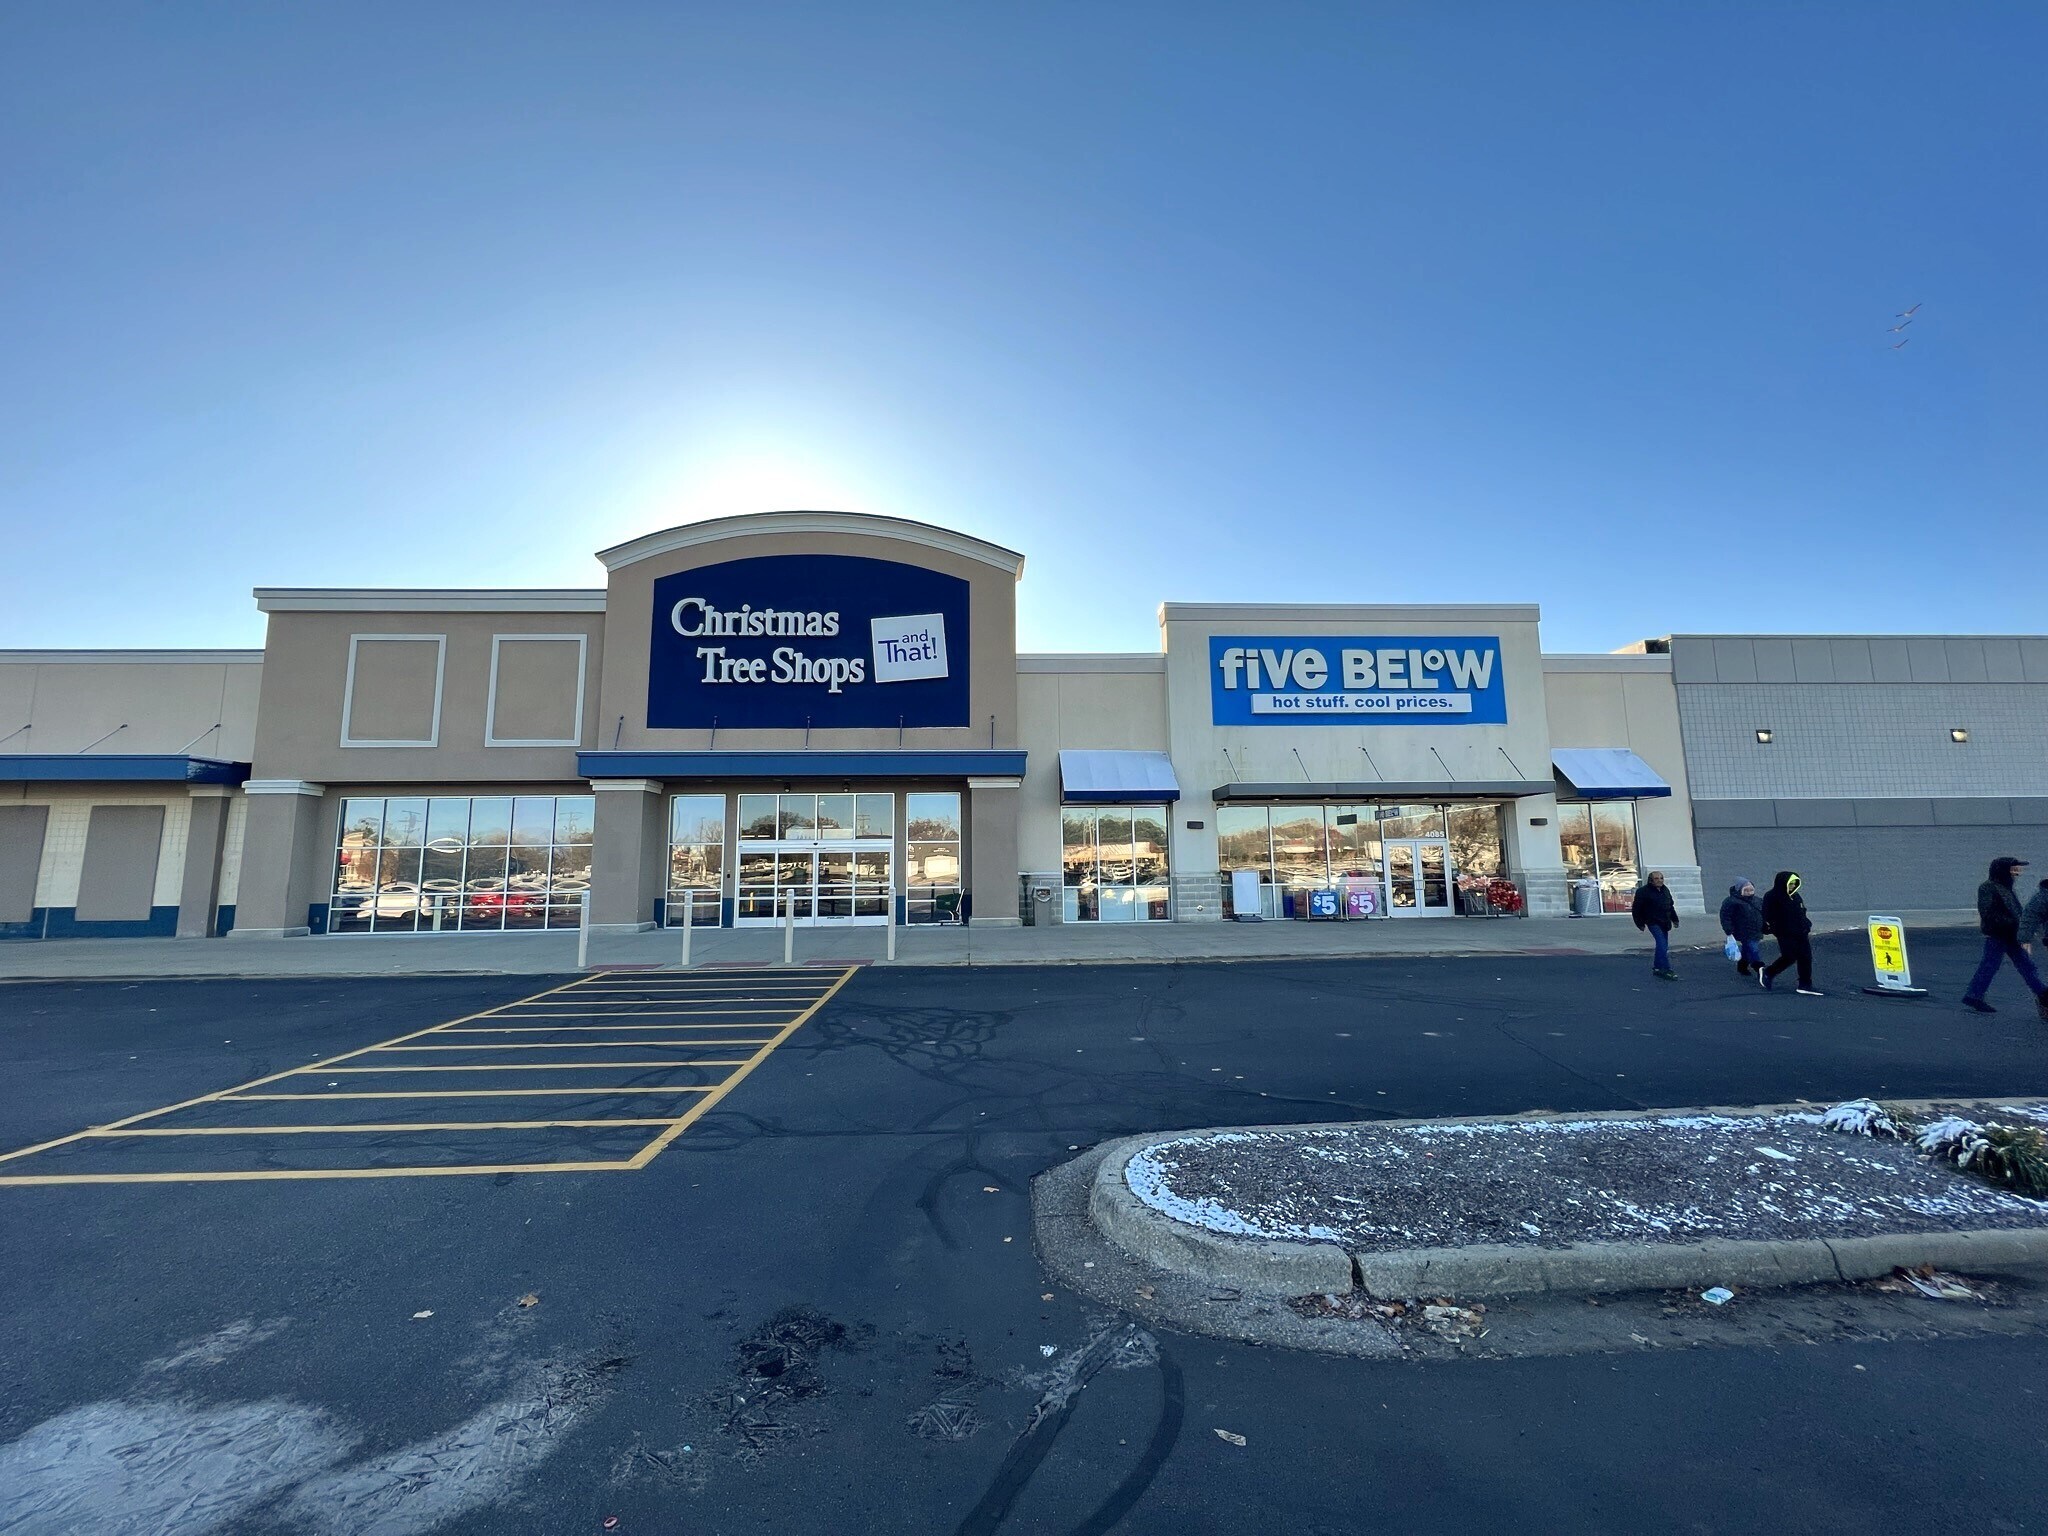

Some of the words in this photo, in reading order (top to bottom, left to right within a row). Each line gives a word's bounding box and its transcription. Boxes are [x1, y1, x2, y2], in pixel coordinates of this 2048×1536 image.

[671, 597, 840, 637] Christmas
[902, 629, 929, 644] and
[878, 637, 938, 663] That!
[696, 647, 766, 684] Tree
[771, 646, 865, 694] Shops
[1219, 648, 1328, 689] five
[1272, 695, 1300, 708] hot
[1305, 695, 1349, 708] stuff.
[1354, 695, 1390, 708] cool
[1396, 695, 1453, 711] prices.
[1313, 895, 1336, 915] $5
[1350, 894, 1374, 914] $5
